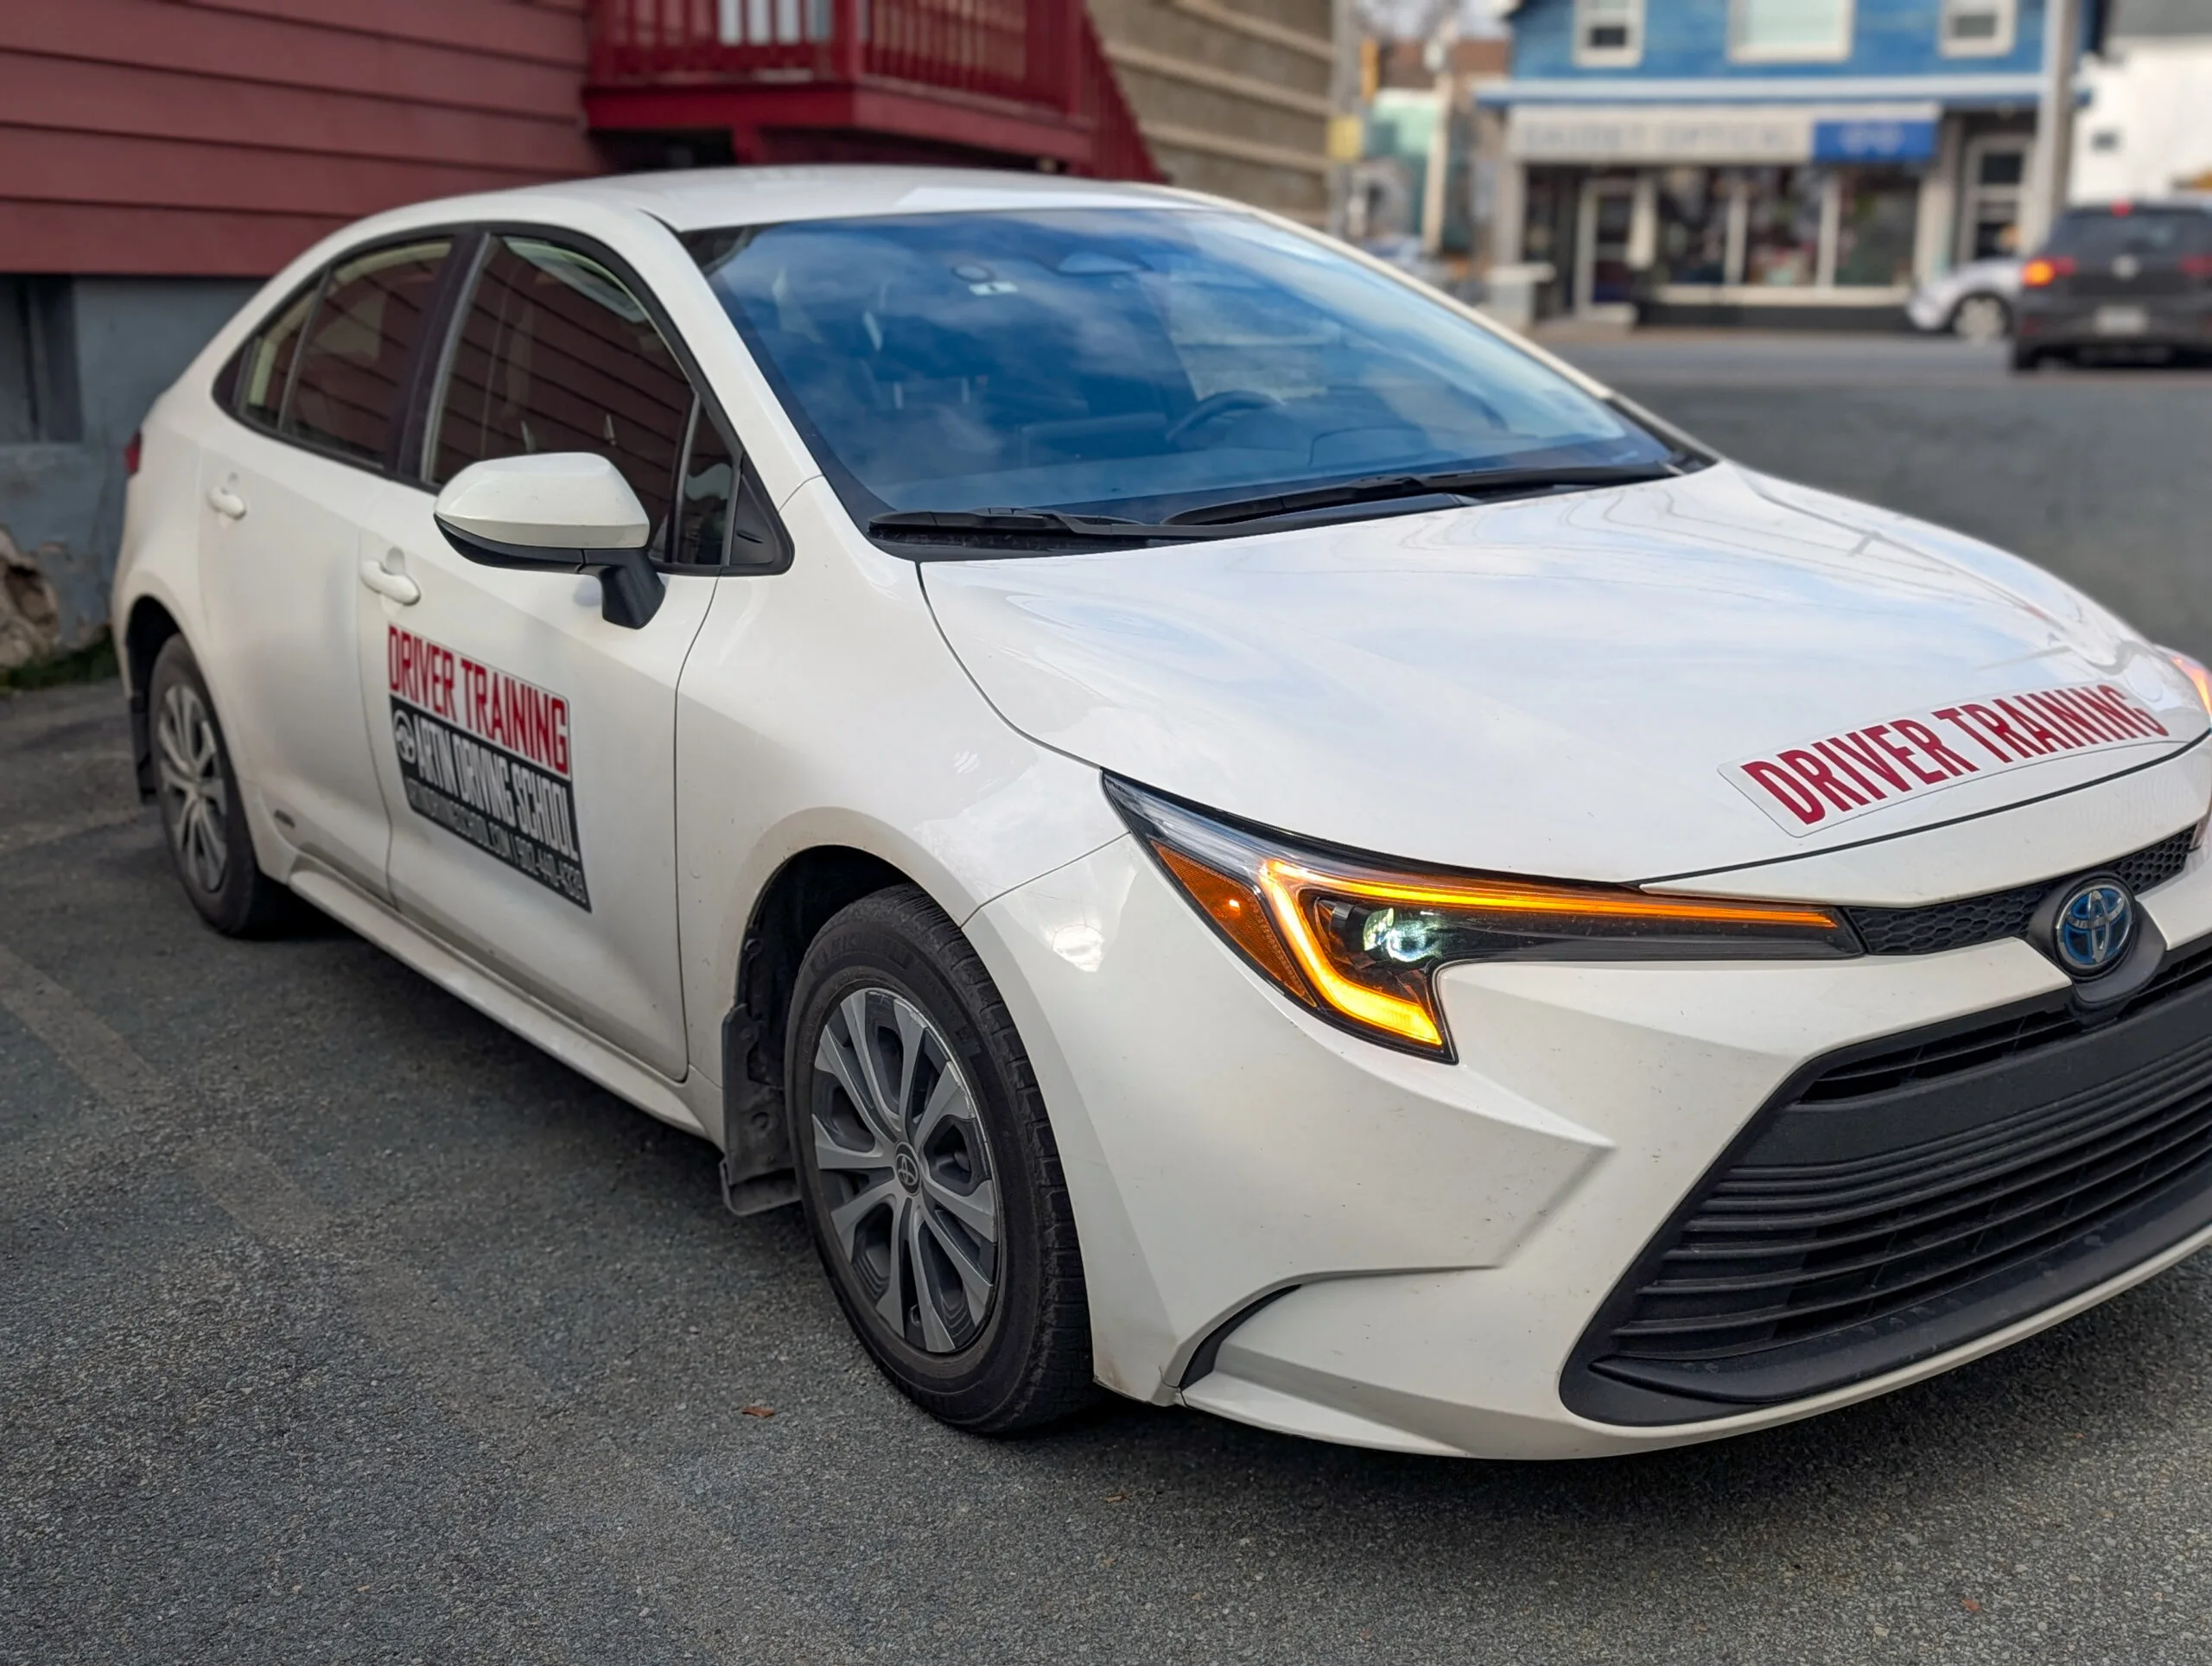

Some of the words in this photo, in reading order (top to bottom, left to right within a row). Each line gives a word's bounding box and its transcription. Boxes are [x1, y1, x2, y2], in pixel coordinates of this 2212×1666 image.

[389, 625, 458, 723] DRIVER
[460, 657, 569, 775] TRAINING
[1740, 718, 1980, 825] DRIVER
[1932, 684, 2170, 764] TRAINING
[413, 714, 460, 798] ARTIN
[452, 733, 518, 829] DRIVING
[511, 762, 579, 862] SCHOOL
